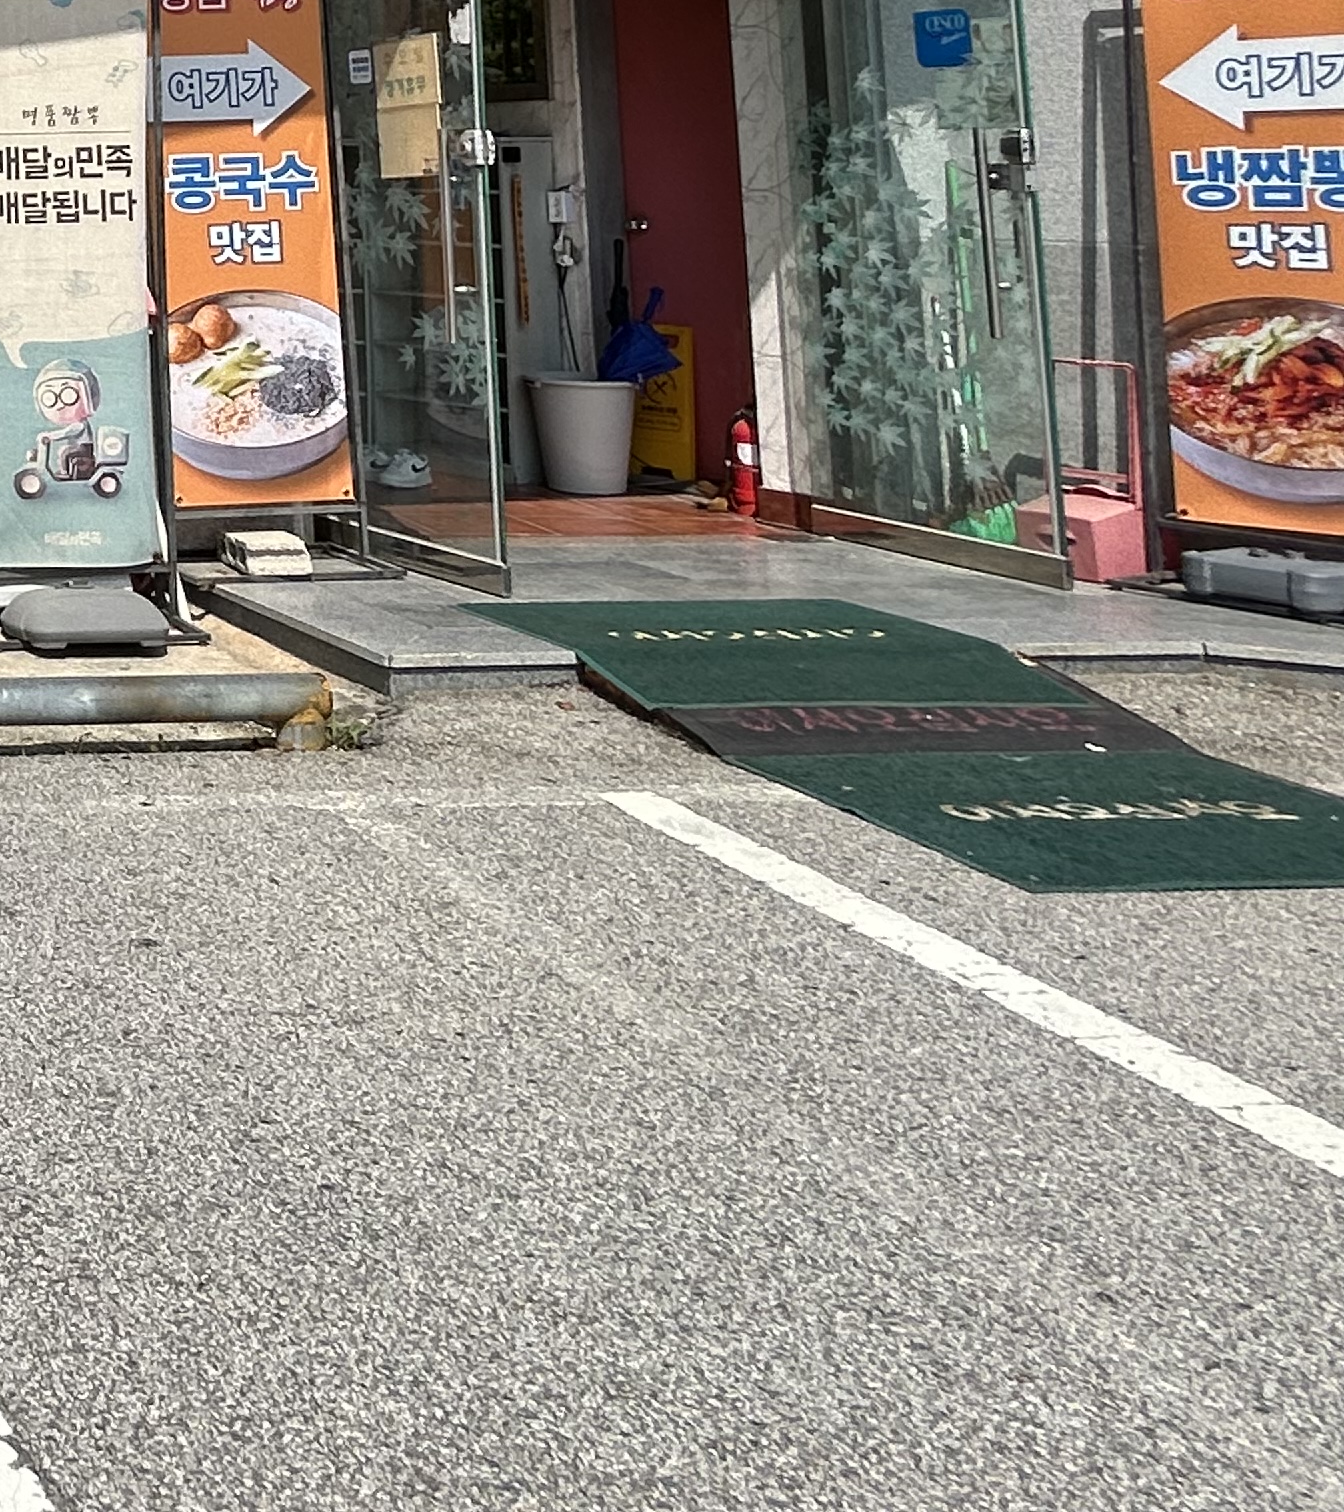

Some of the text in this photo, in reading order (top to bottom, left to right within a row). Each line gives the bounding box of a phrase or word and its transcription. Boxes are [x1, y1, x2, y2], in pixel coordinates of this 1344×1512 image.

[167, 66, 278, 110] 여기가
[167, 151, 319, 212] 콩국수
[208, 220, 284, 265] 맛집
[1226, 222, 1332, 271] 맛집
